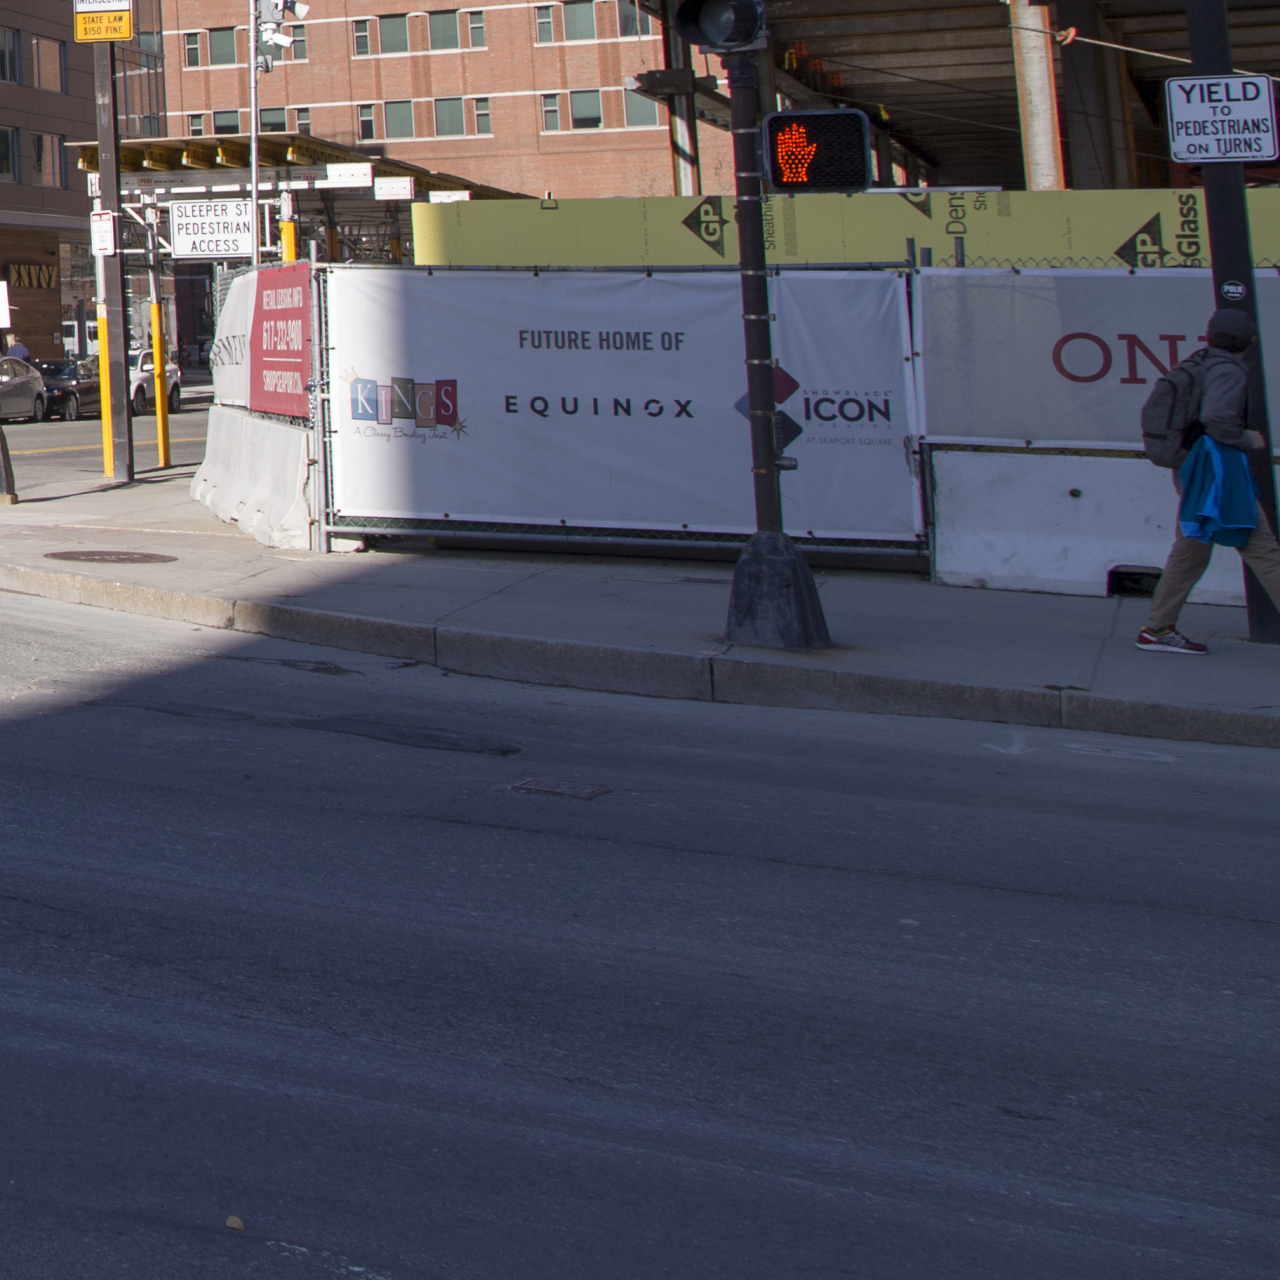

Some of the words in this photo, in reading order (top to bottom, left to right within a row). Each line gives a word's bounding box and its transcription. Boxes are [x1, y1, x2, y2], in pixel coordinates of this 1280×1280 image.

[82, 15, 104, 25] STATE
[107, 14, 124, 23] LAW
[83, 26, 102, 36] $150
[105, 25, 123, 34] FINE
[1177, 81, 1261, 104] YIELD
[1209, 105, 1231, 117] TO
[1175, 117, 1270, 137] PEDESTRIANS
[1186, 143, 1209, 154] ON
[1214, 137, 1262, 154] TURNS
[176, 204, 228, 218] SLEEPER
[235, 203, 248, 216] ST
[177, 221, 250, 235] PEDESTRIAN
[701, 204, 721, 242] GP
[191, 239, 239, 252] ACCESS
[1223, 284, 1244, 294] POLK
[262, 289, 276, 310] RETAIL
[518, 330, 592, 350] FUTURE
[598, 331, 654, 351] HOME
[660, 332, 685, 351] OF
[1052, 332, 1210, 384] ON
[803, 389, 889, 397] SHOWPLACE
[356, 383, 453, 420] KINGS
[504, 395, 694, 418] EQUINOX
[803, 397, 891, 422] ICON
[805, 422, 892, 430] THEATRE
[819, 437, 855, 445] SEAPORT
[860, 438, 893, 446] SQUARE
